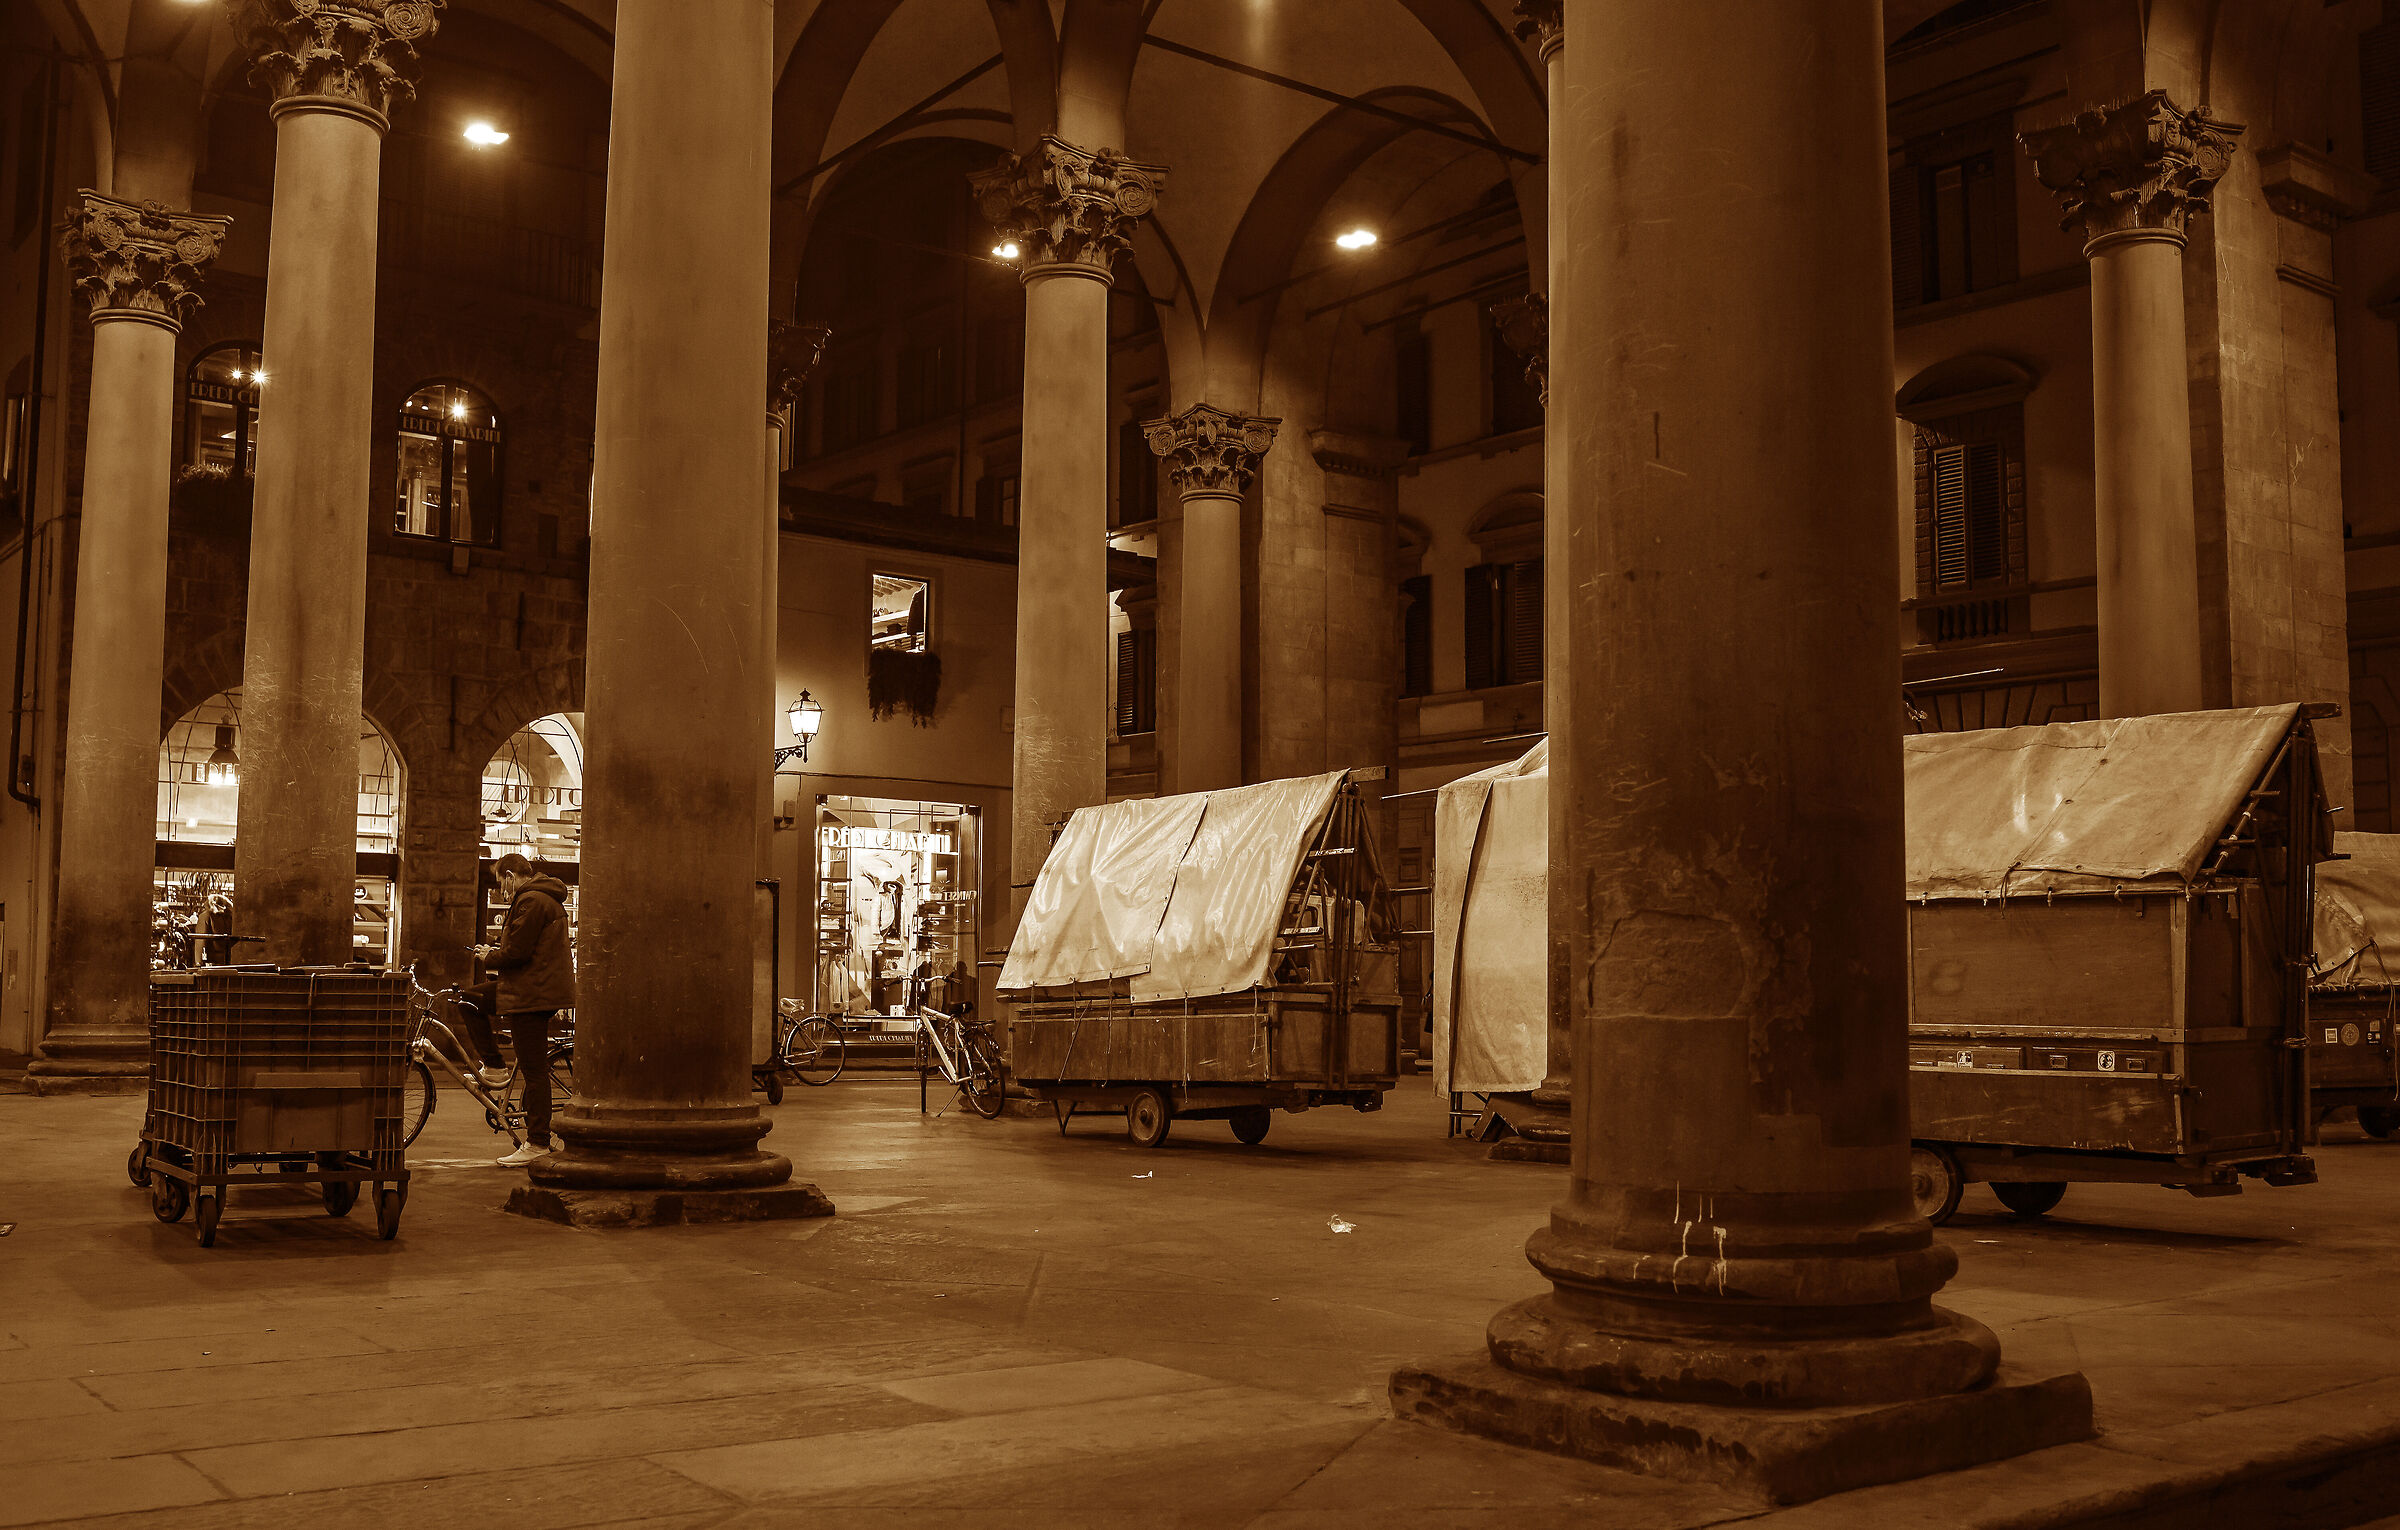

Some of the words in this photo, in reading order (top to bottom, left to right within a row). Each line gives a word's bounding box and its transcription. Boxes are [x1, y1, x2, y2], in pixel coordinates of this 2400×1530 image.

[191, 382, 233, 401] EREDI
[403, 416, 441, 434] EREDI
[444, 423, 501, 442] CHIARINI
[504, 785, 562, 806] EREDI
